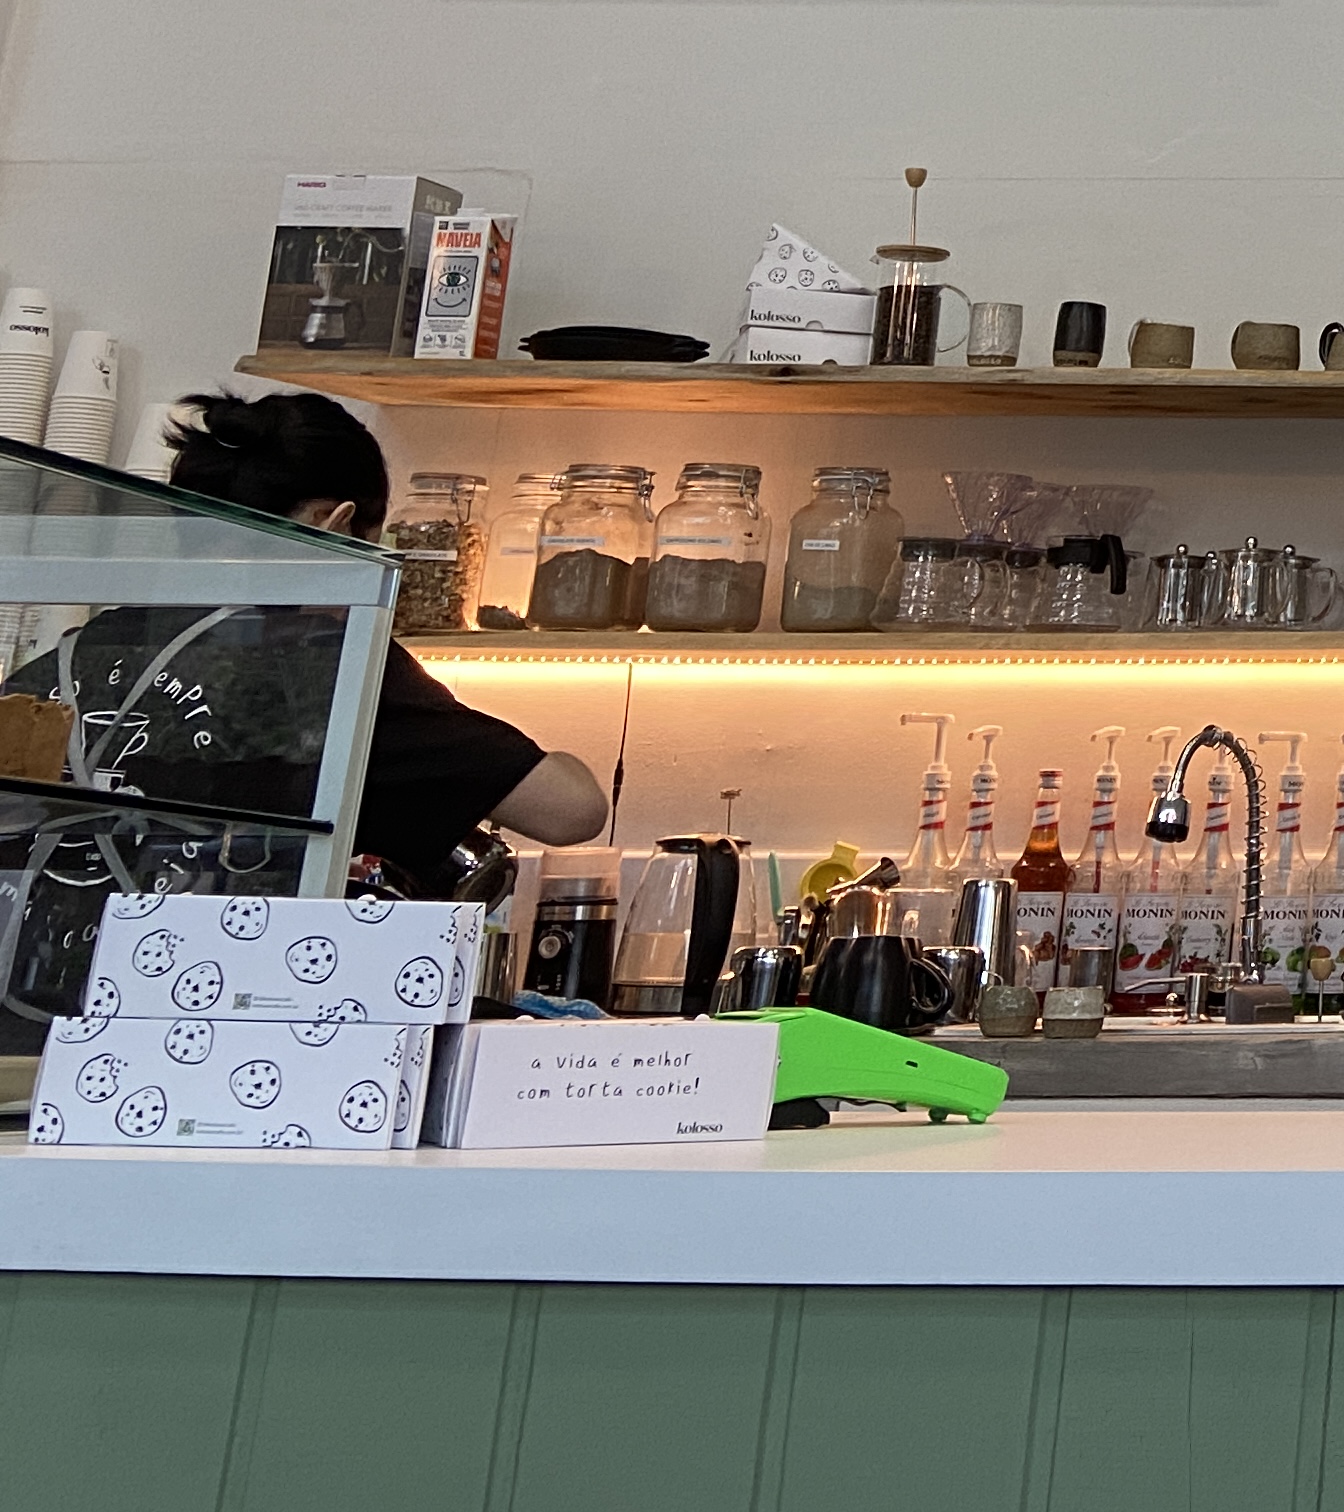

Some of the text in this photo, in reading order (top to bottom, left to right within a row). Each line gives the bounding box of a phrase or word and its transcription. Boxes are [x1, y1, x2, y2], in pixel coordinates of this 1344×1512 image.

[436, 232, 481, 248] NAVEIA
[749, 309, 801, 323] kolosso
[749, 350, 801, 362] kolosso
[1017, 906, 1056, 918] ONIN
[1127, 907, 1175, 919] MONIN
[531, 1051, 692, 1069] a vida é melhor
[517, 1088, 550, 1100] com
[677, 1122, 723, 1134] kolosso
